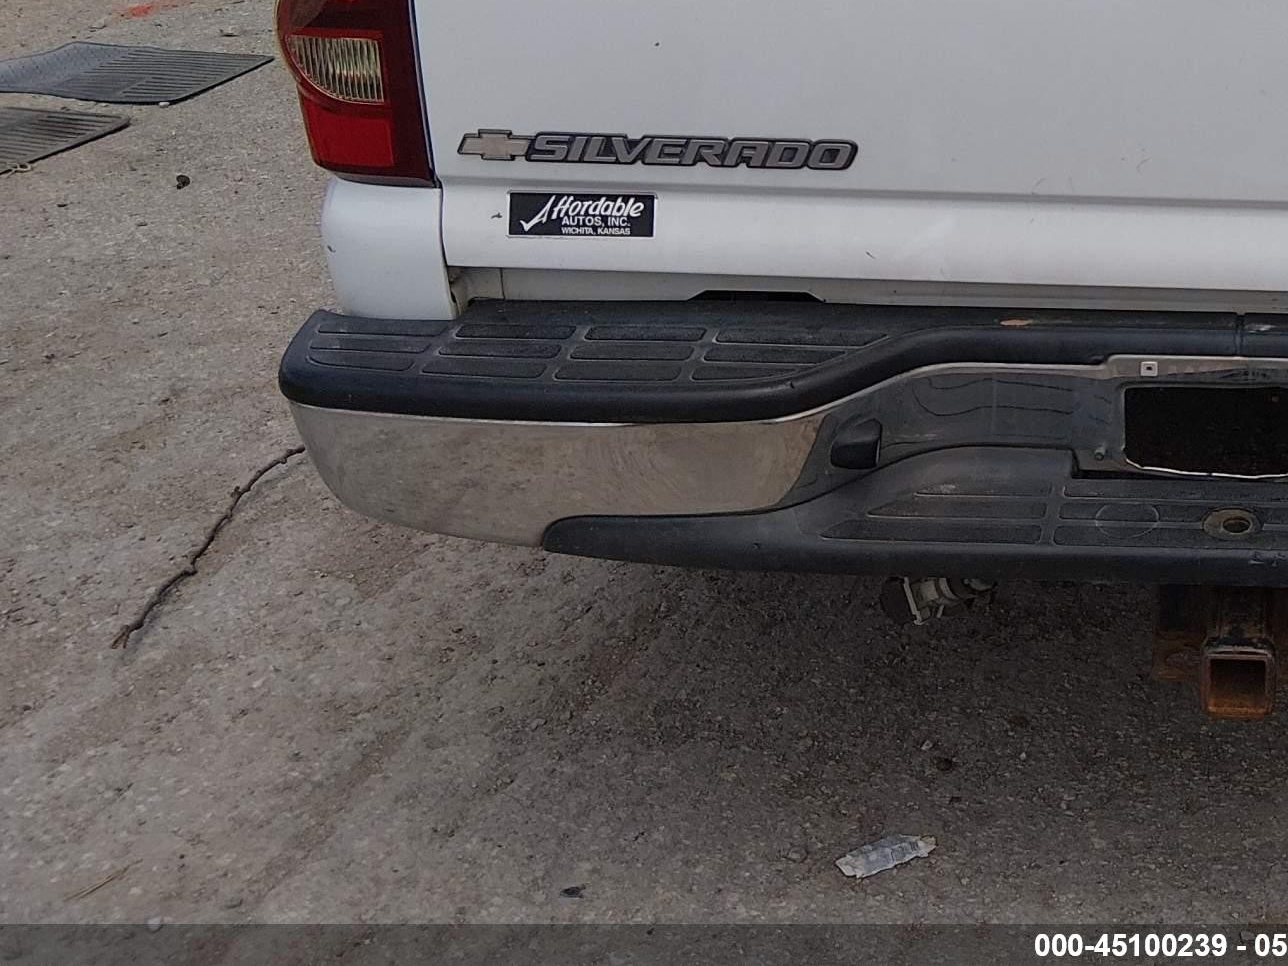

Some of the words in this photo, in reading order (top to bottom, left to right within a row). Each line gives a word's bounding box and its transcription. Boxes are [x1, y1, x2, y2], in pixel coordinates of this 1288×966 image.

[526, 131, 859, 170] SILVERADO
[520, 195, 645, 232] Affordable
[561, 215, 605, 227] AUTOS,
[607, 217, 631, 227] INC.
[561, 226, 596, 236] WICHITA,
[599, 227, 631, 236] KANSAS
